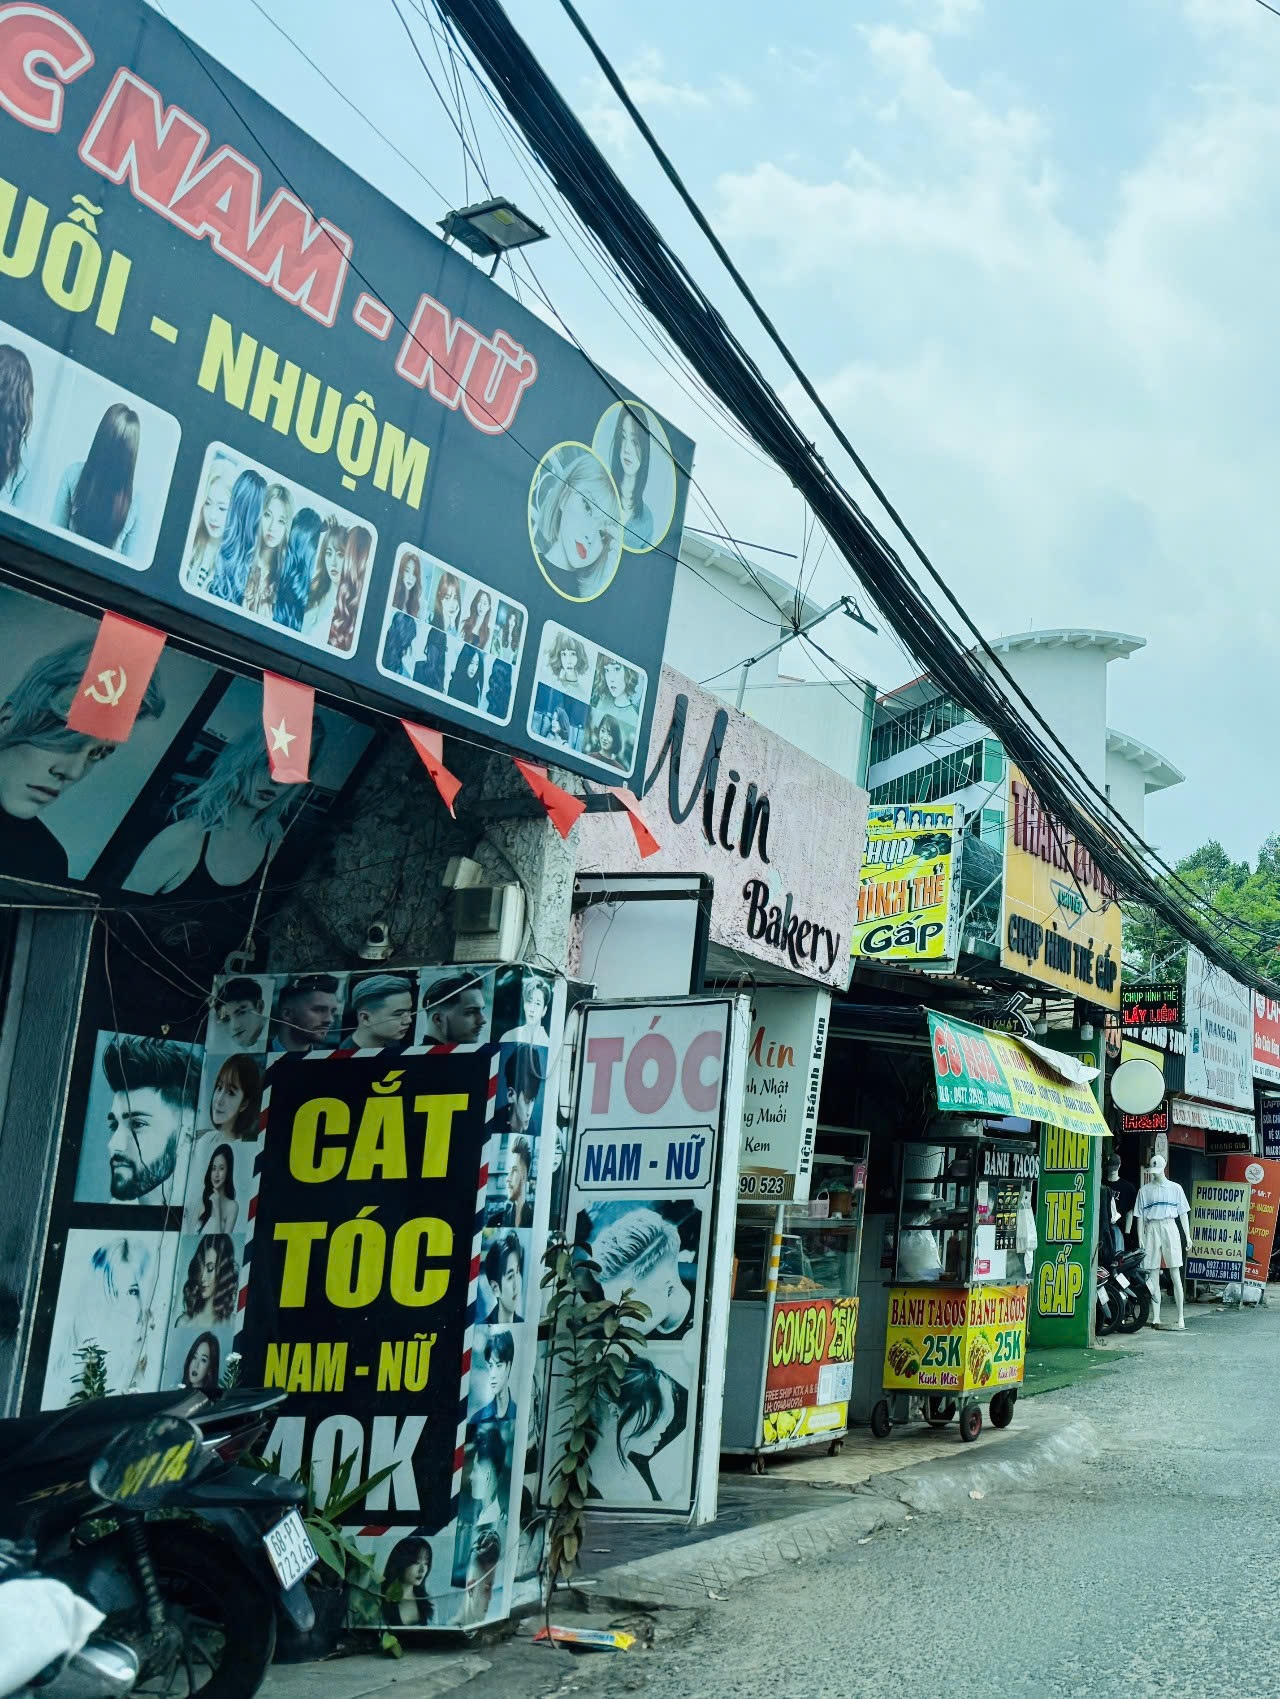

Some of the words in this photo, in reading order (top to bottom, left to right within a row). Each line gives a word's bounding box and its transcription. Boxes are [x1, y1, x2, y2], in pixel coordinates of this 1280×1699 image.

[78, 67, 353, 327] NAM
[395, 294, 537, 434] NỮ
[197, 313, 431, 510] NHUỘM
[643, 693, 770, 863] Min
[865, 836, 915, 869] HỤP
[743, 879, 840, 974] Bakery
[861, 914, 943, 954] Gấp
[1008, 912, 1043, 967] CHỤP
[1044, 921, 1072, 975] HÌNH
[1073, 937, 1094, 985] THẺ
[1096, 943, 1118, 993] GẤP
[1124, 991, 1143, 1004] CHỤP
[1145, 990, 1161, 1002] HÌNH
[1124, 1004, 1147, 1022] LẤY
[1149, 1003, 1177, 1022] LIỀN
[587, 1016, 723, 1114] TÓC
[760, 1077, 789, 1098] Nhật
[289, 1070, 468, 1183] CẮT
[757, 1103, 787, 1124] Muối
[1124, 1113, 1166, 1129] H&N
[584, 1143, 642, 1181] NAM
[665, 1134, 706, 1181] NỮ
[745, 1137, 770, 1153] Kem
[983, 1144, 1010, 1177] BÁNH
[1013, 1153, 1040, 1179] TACOS
[759, 1177, 784, 1194] 523
[1196, 1186, 1245, 1203] PHOTOCOPY
[1045, 1173, 1086, 1242] THẺ
[272, 1206, 454, 1308] TÓC
[1191, 1244, 1223, 1256] KHANG
[1225, 1248, 1243, 1258] GIA
[1038, 1244, 1083, 1316] GẤP
[891, 1290, 925, 1327] BÁNH
[927, 1298, 967, 1327] TACOS
[969, 1290, 996, 1328] BÁNH
[998, 1295, 1026, 1326] TACOS
[772, 1305, 827, 1368] COMBO
[827, 1305, 857, 1363] 25K
[921, 1334, 963, 1368] 25K
[993, 1329, 1023, 1364] 25K
[264, 1342, 348, 1393] NAM
[376, 1332, 437, 1393] NỮ
[765, 1389, 779, 1401] FREE
[270, 1516, 300, 1557] 68-P1
[277, 1537, 314, 1587] 723.46
